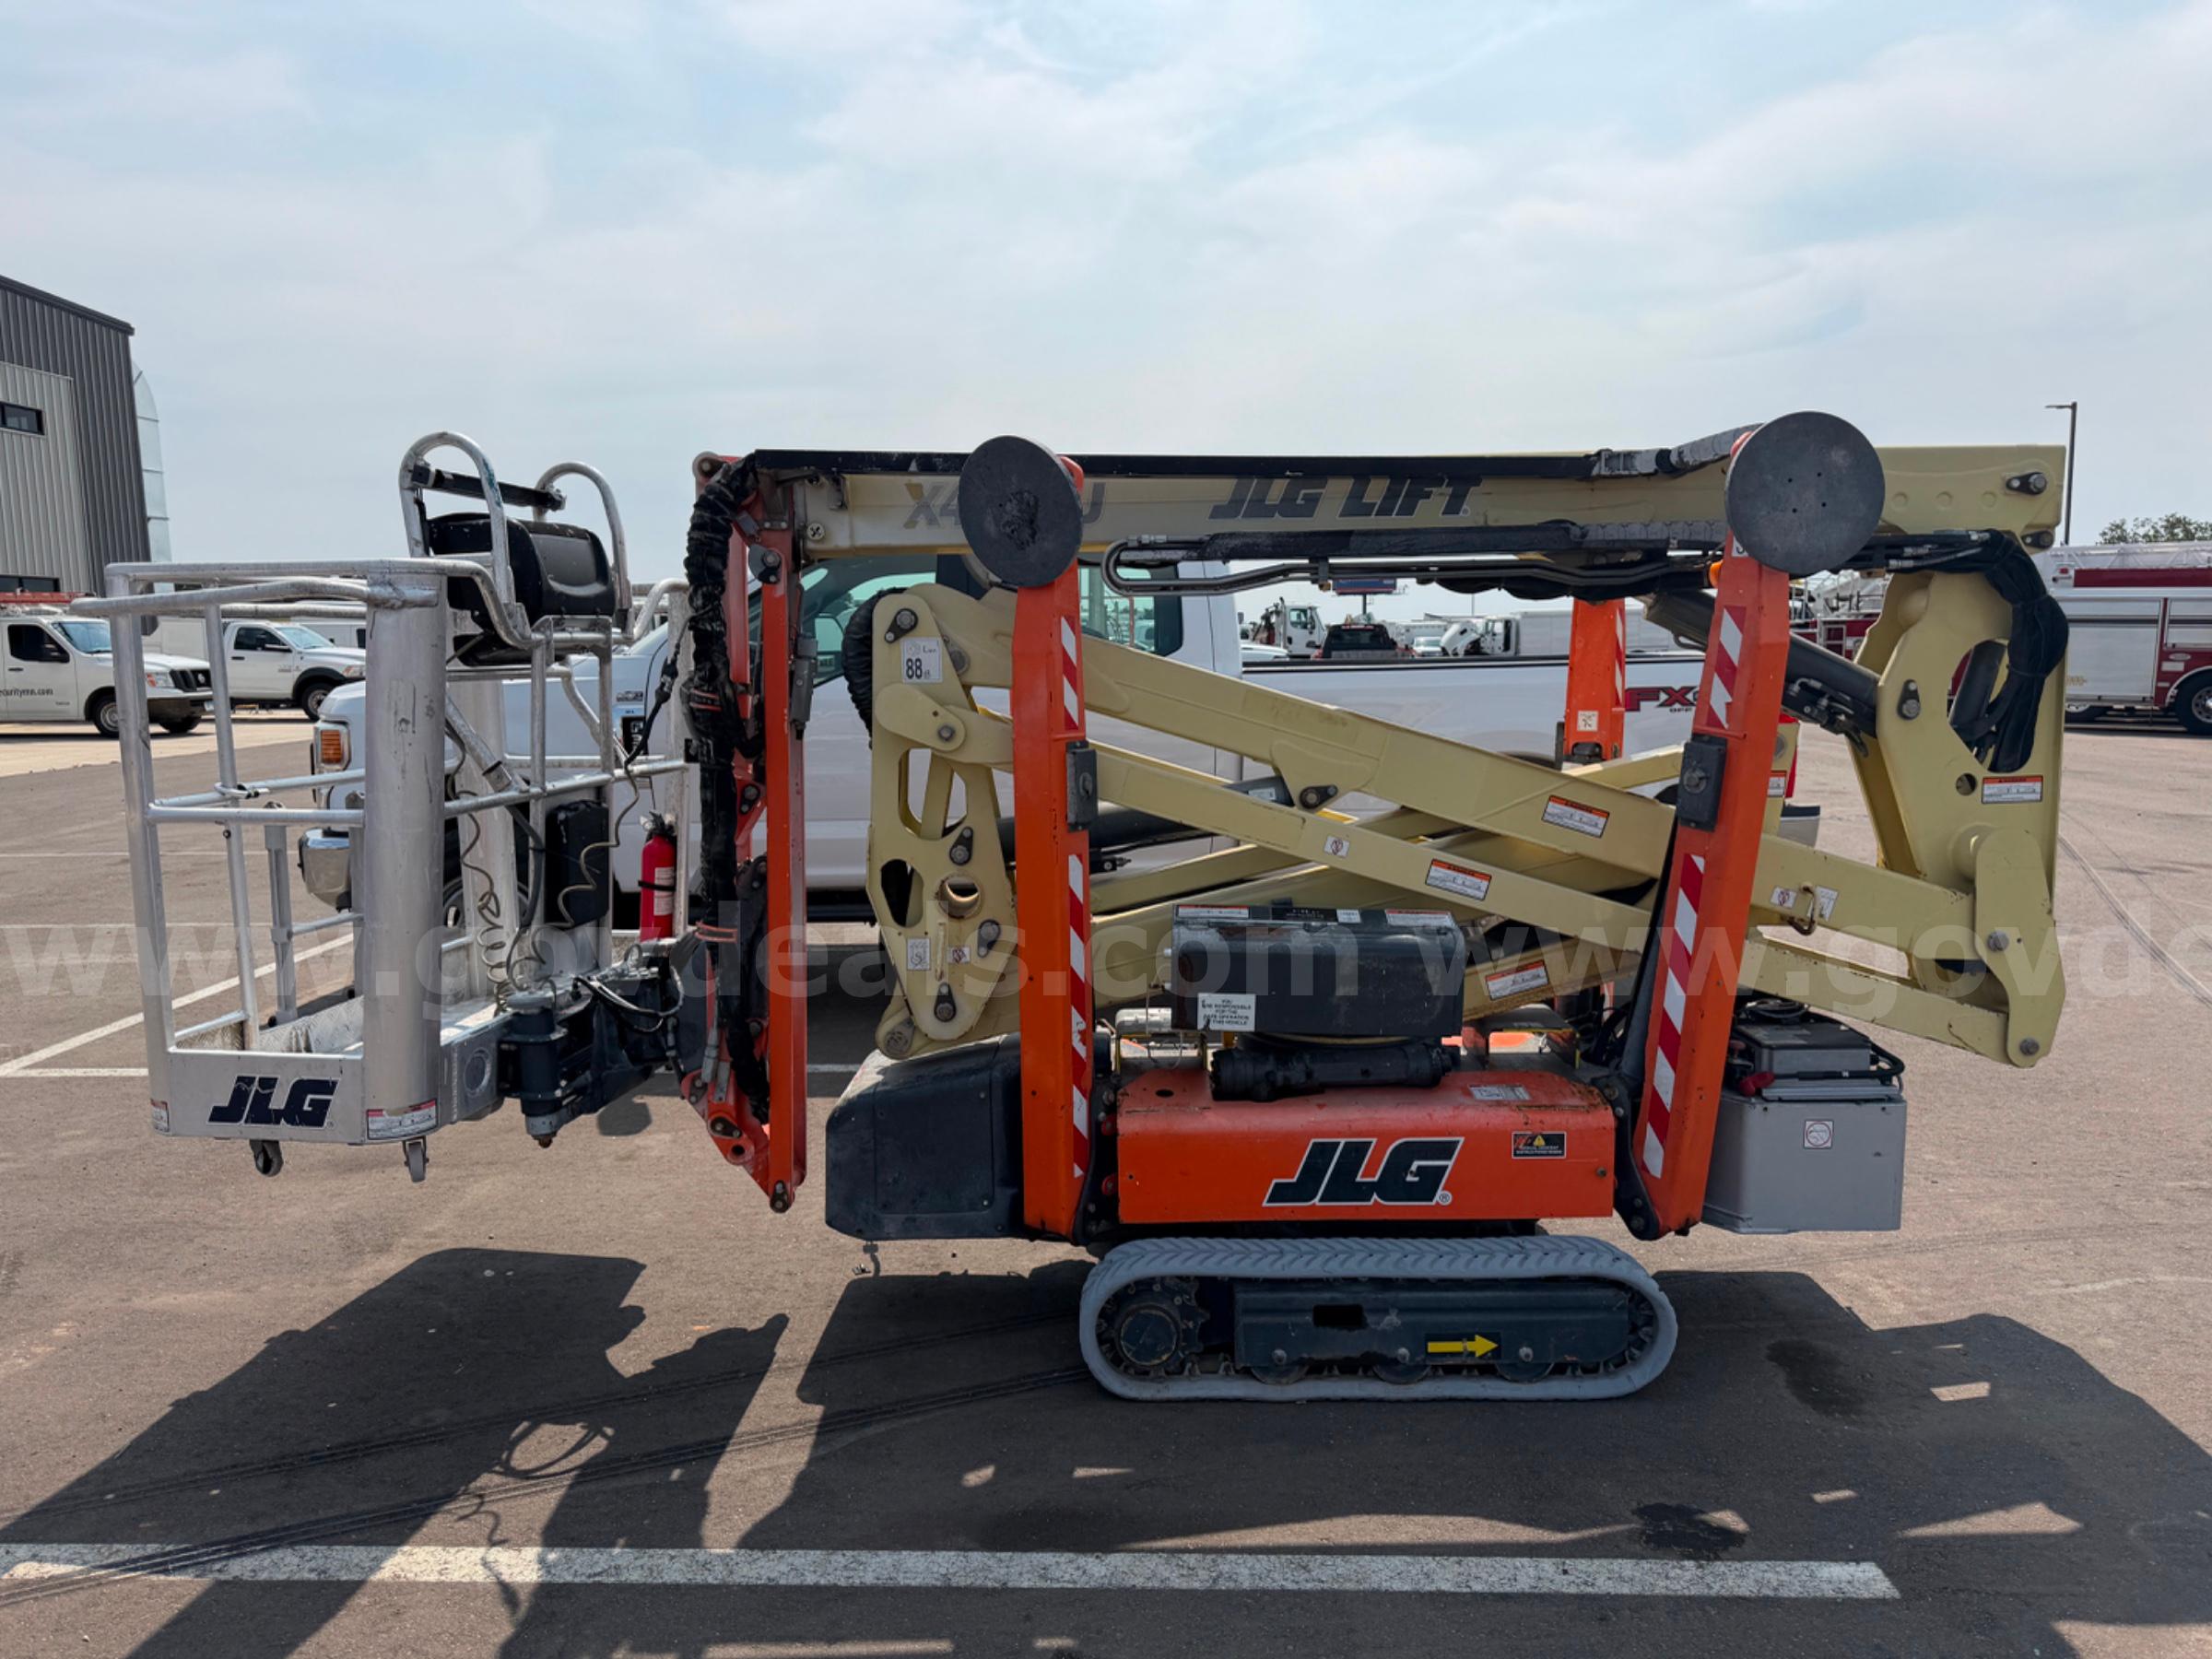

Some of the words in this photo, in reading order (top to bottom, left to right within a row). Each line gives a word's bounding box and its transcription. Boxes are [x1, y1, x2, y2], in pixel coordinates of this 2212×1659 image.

[1208, 477, 1328, 519] JLG
[1337, 477, 1483, 518] LIFT
[906, 658, 923, 679] 88
[1625, 686, 1700, 712] FX
[207, 1074, 341, 1129] JLG
[1262, 1137, 1465, 1206] JLG
